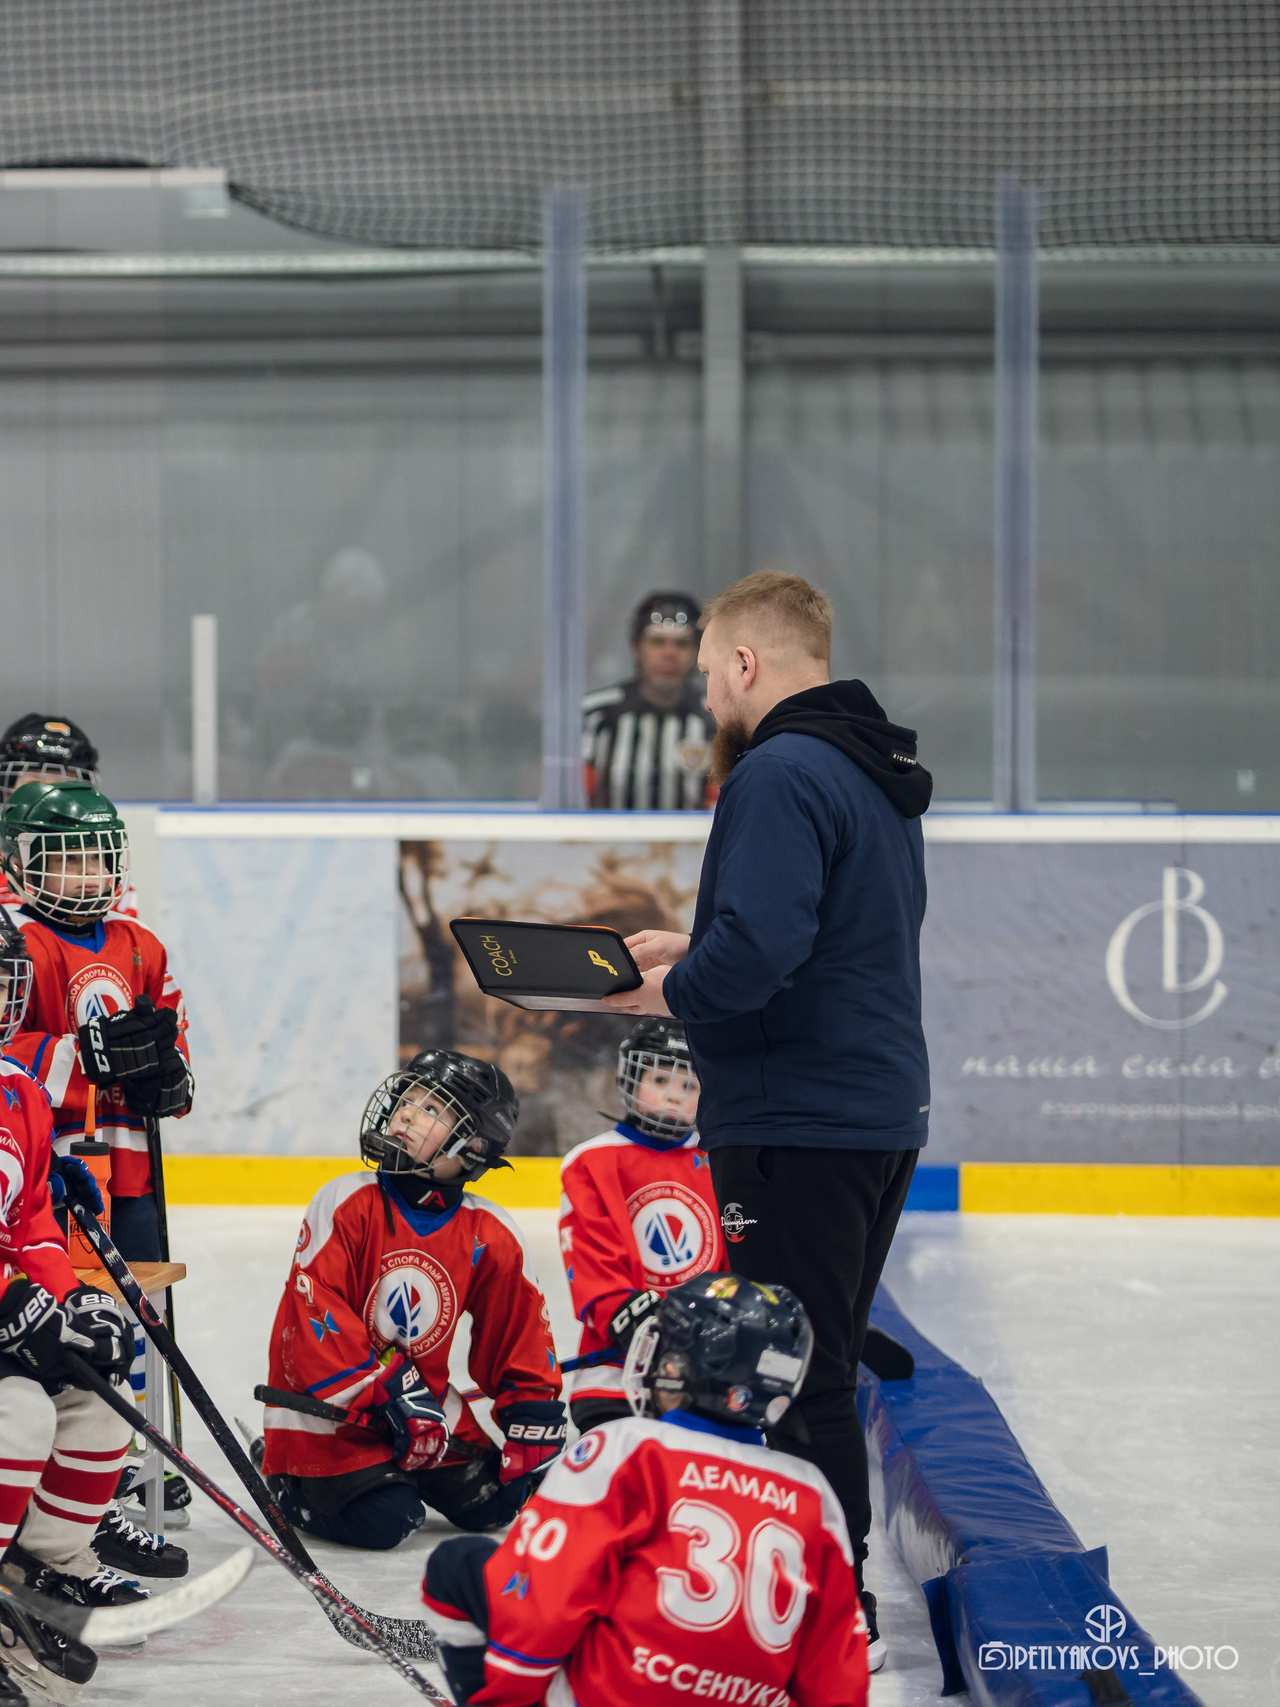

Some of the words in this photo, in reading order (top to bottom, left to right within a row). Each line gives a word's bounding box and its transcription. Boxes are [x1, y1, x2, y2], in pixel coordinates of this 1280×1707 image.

[479, 935, 513, 977] COACH
[0, 1136, 17, 1152] ИЛЬ
[438, 1281, 451, 1327] АВЕРБУХА
[678, 1461, 798, 1516] ДЕЛИДИ
[514, 1508, 569, 1561] 30
[655, 1497, 813, 1655] 30
